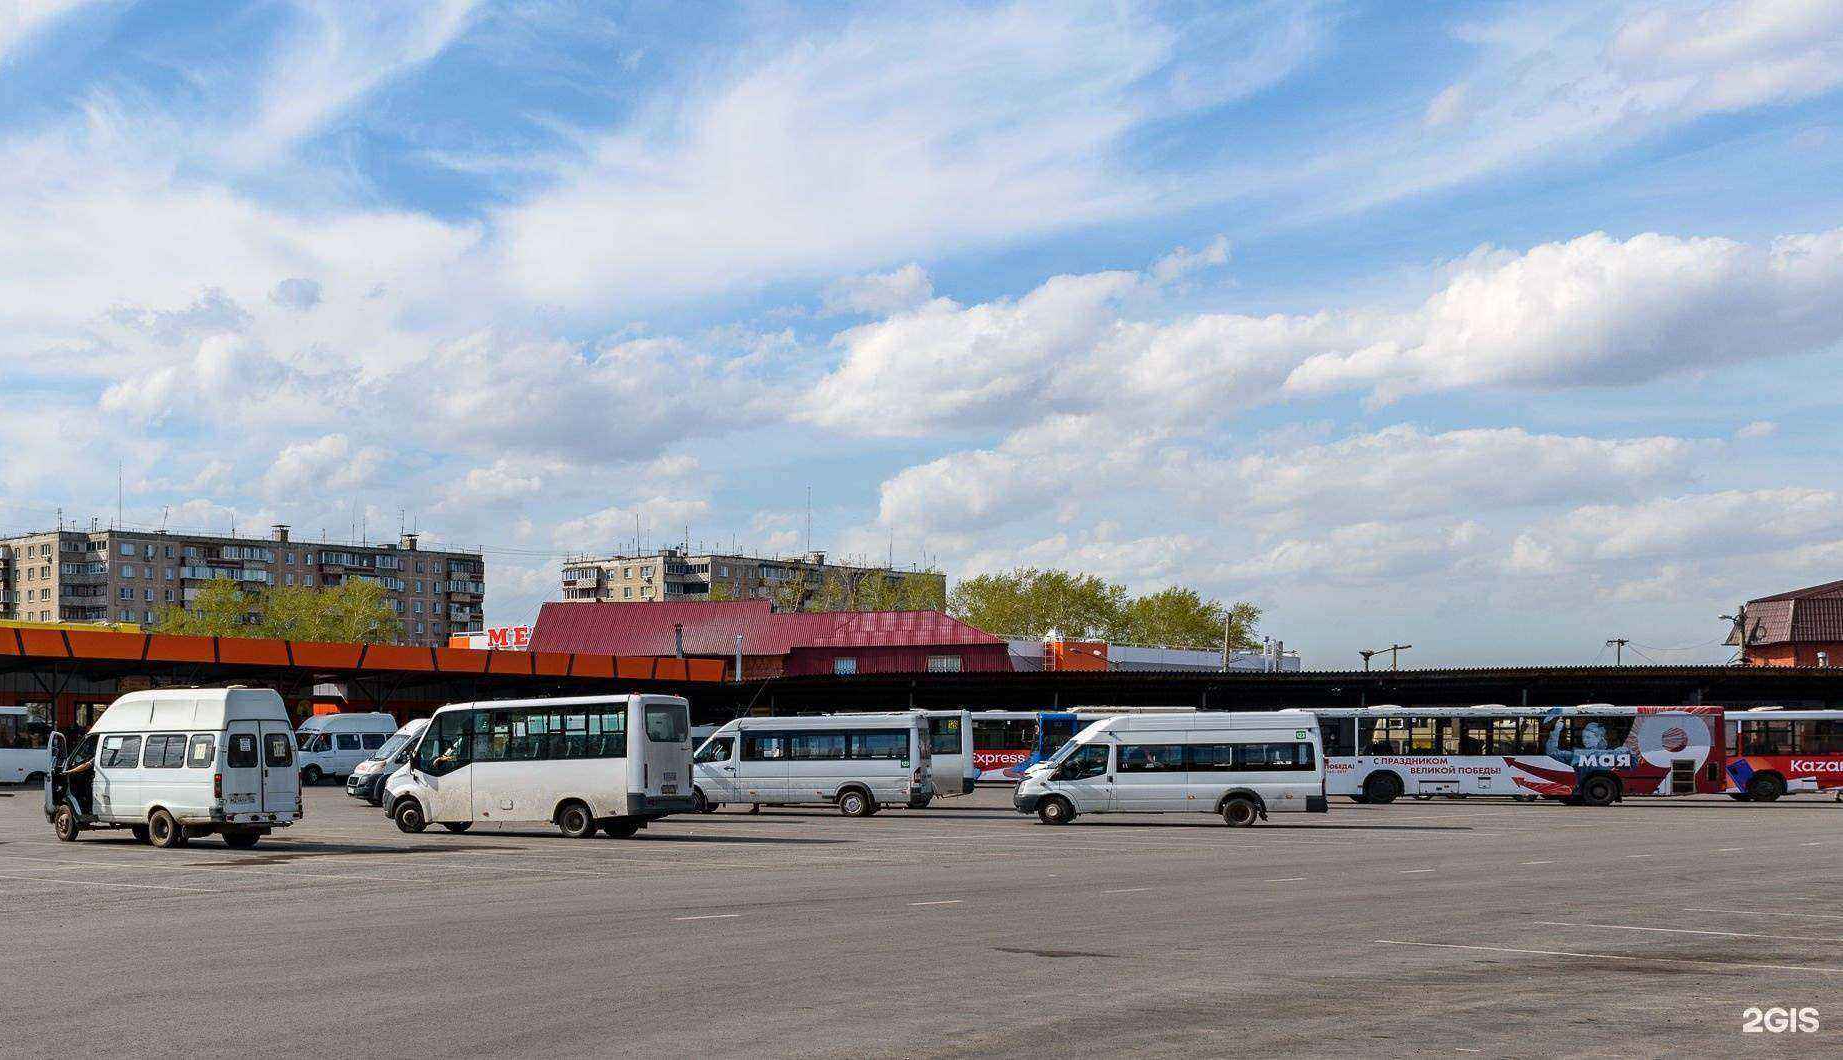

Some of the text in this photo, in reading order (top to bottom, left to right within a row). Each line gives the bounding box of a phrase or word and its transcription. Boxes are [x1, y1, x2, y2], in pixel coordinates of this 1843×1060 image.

[1373, 757, 1449, 766] С ПРАЗДНИКОМ
[1410, 766, 1502, 775] ВЕЛИКОЙ ПОБЕДЫ!
